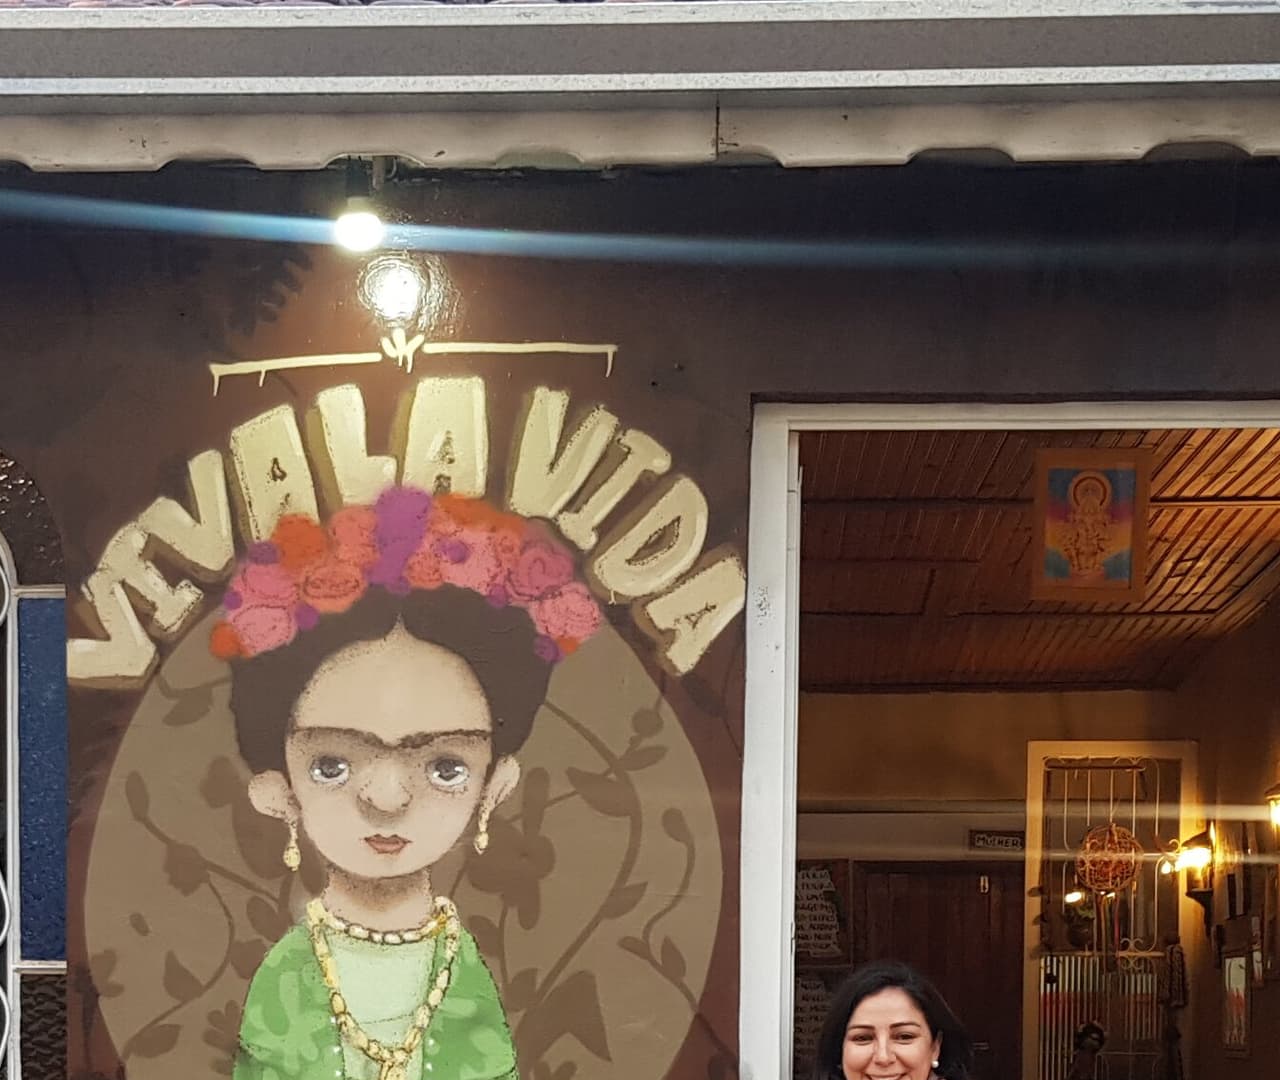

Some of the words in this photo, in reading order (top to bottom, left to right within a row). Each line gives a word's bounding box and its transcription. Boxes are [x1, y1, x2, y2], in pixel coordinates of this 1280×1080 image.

[67, 403, 321, 679] VIVA
[315, 376, 488, 506] LA
[507, 386, 748, 675] VIDA
